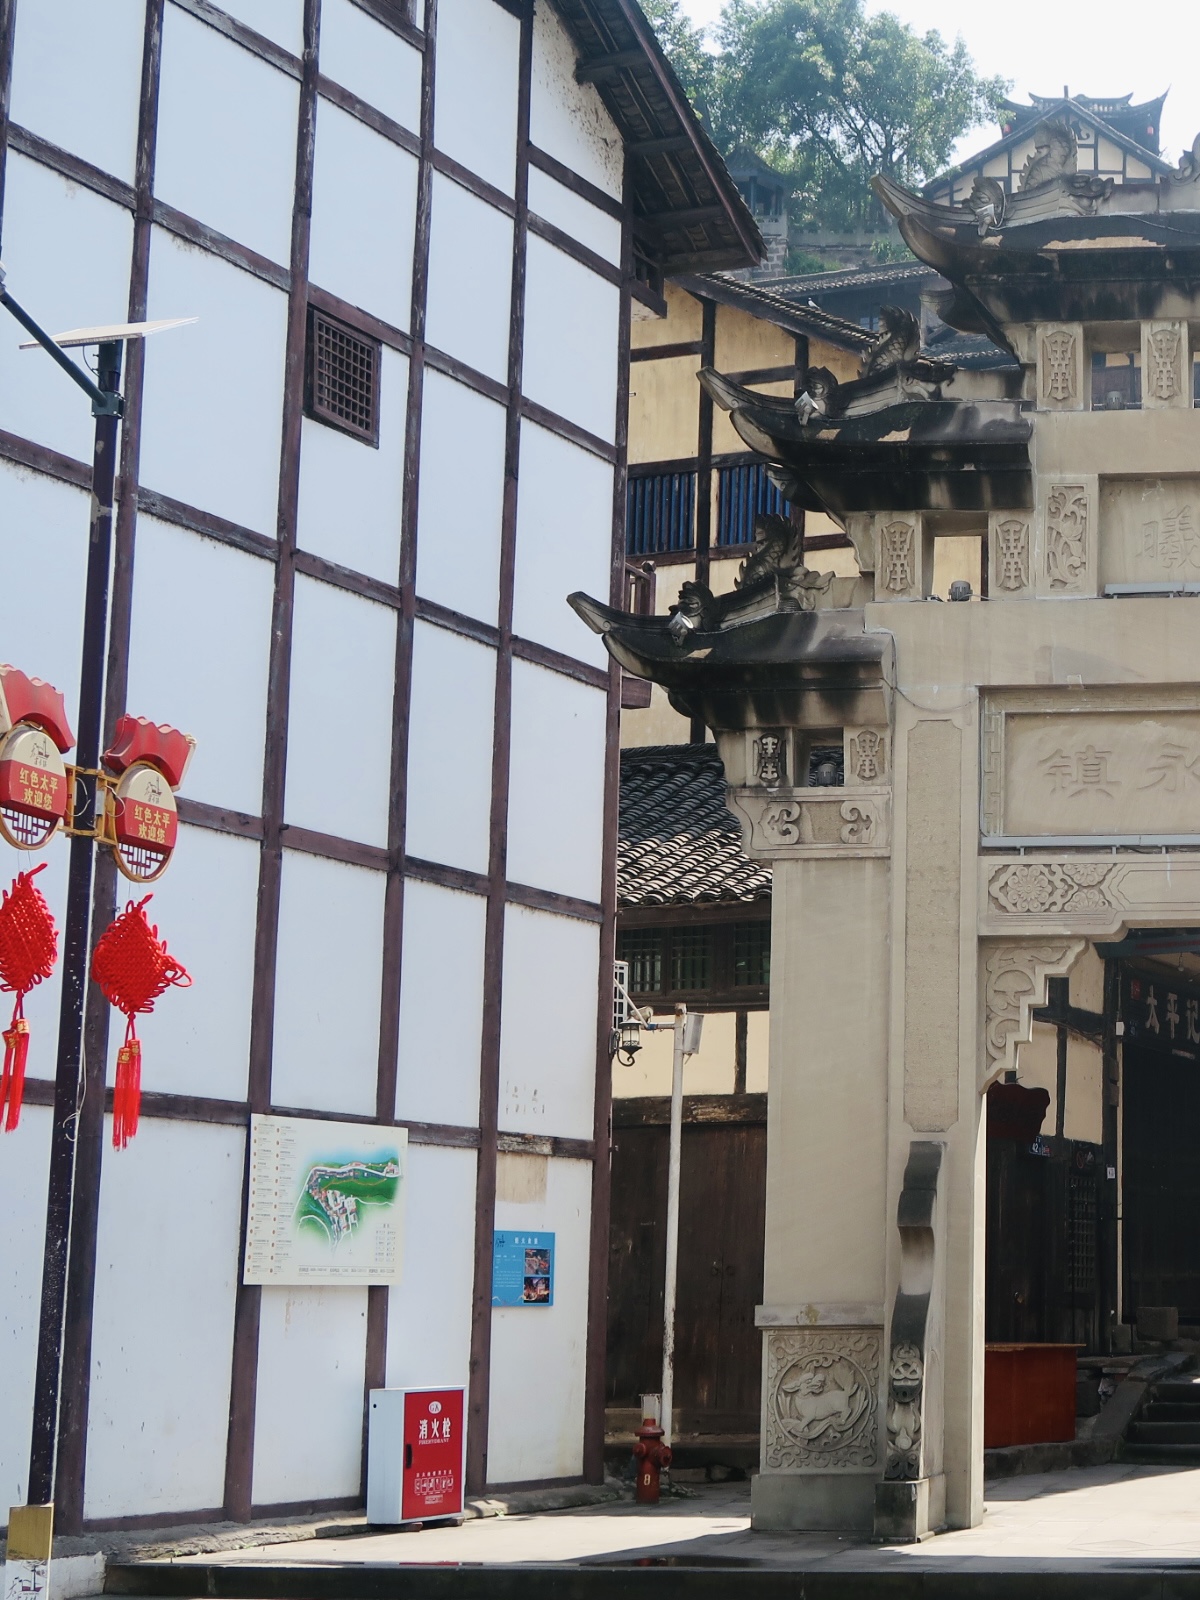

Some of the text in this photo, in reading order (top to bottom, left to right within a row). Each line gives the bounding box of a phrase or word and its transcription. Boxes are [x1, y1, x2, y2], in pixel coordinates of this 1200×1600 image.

[19, 767, 59, 796] 红色太平
[23, 788, 53, 811] 欢迎您
[134, 804, 171, 829] 红色太平
[138, 822, 166, 844] 欢迎您
[418, 1417, 451, 1439] 消火栓
[643, 1473, 651, 1486] 8
